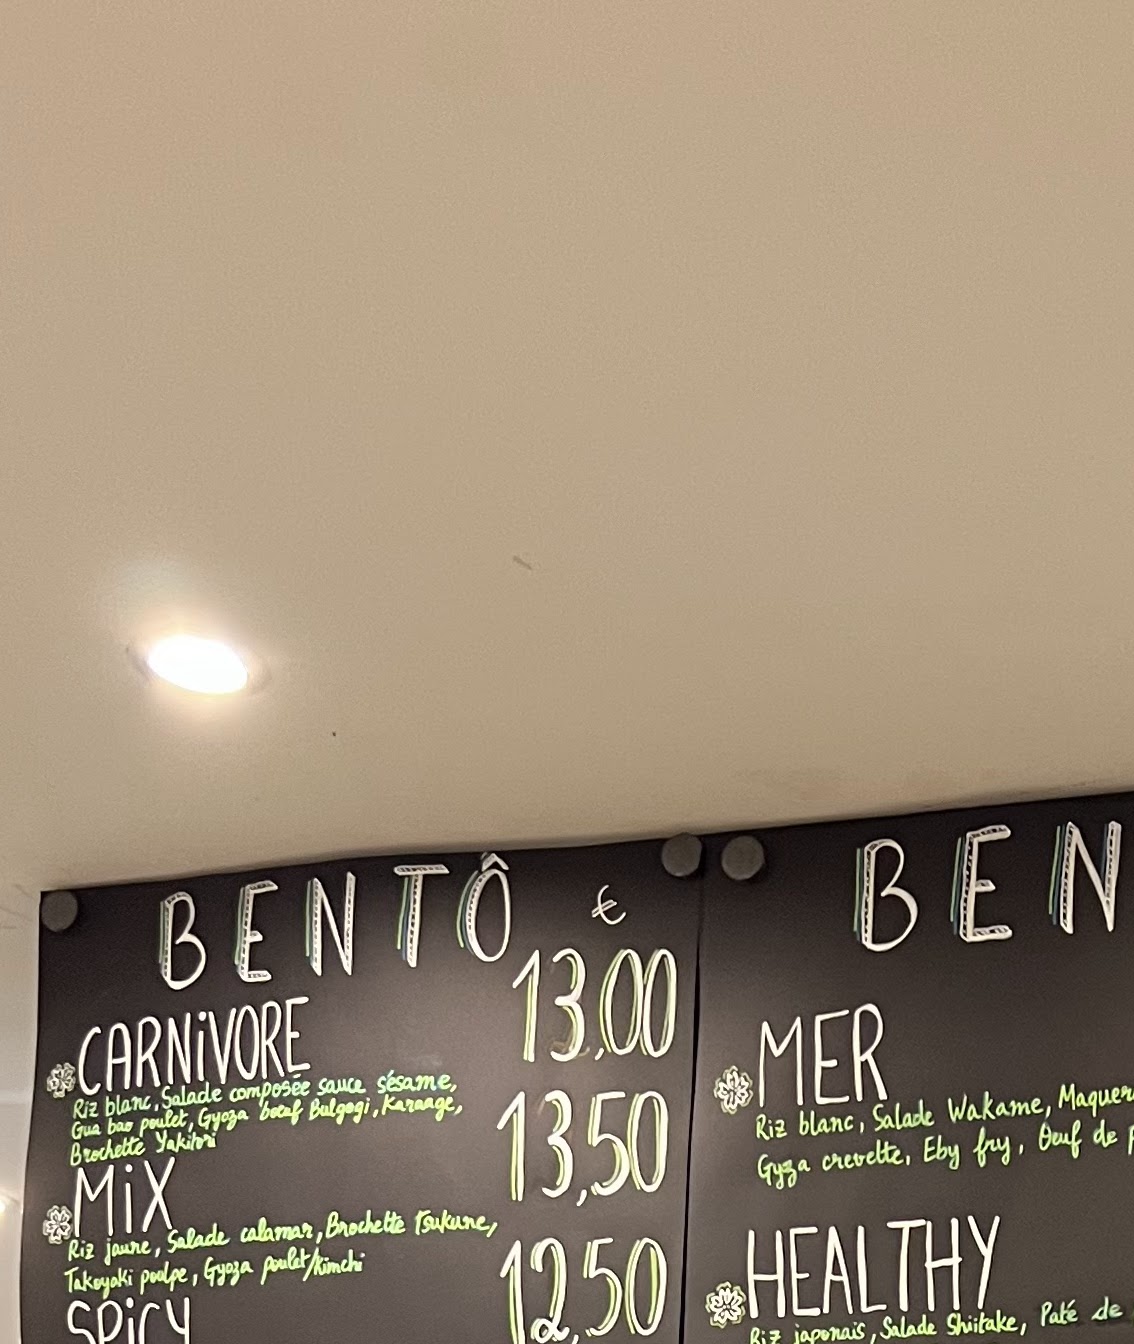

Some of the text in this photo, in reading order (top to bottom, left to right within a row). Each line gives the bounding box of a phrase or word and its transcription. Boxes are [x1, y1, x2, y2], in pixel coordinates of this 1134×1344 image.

[512, 948, 677, 1062] 13,00
[759, 1003, 887, 1108] MER
[74, 1070, 457, 1118] Riz Salade sésame,
[756, 1114, 788, 1139] Riz
[799, 1107, 864, 1138] blanc,
[873, 1101, 935, 1133] Salade
[948, 1094, 1051, 1126] Wakame,
[72, 1120, 101, 1140] Gua
[139, 1109, 194, 1138] poulet,
[498, 1090, 670, 1206] 13,50
[924, 1141, 960, 1169] Eby
[1093, 1121, 1118, 1146] de
[71, 1138, 145, 1166] Brochette
[69, 1214, 405, 1265] Riz jaune, Salade Brochette
[746, 1215, 1001, 1319] HEALTHY
[879, 1317, 938, 1339] Salade
[946, 1308, 1027, 1337] Shiitake,
[1092, 1297, 1122, 1320] de
